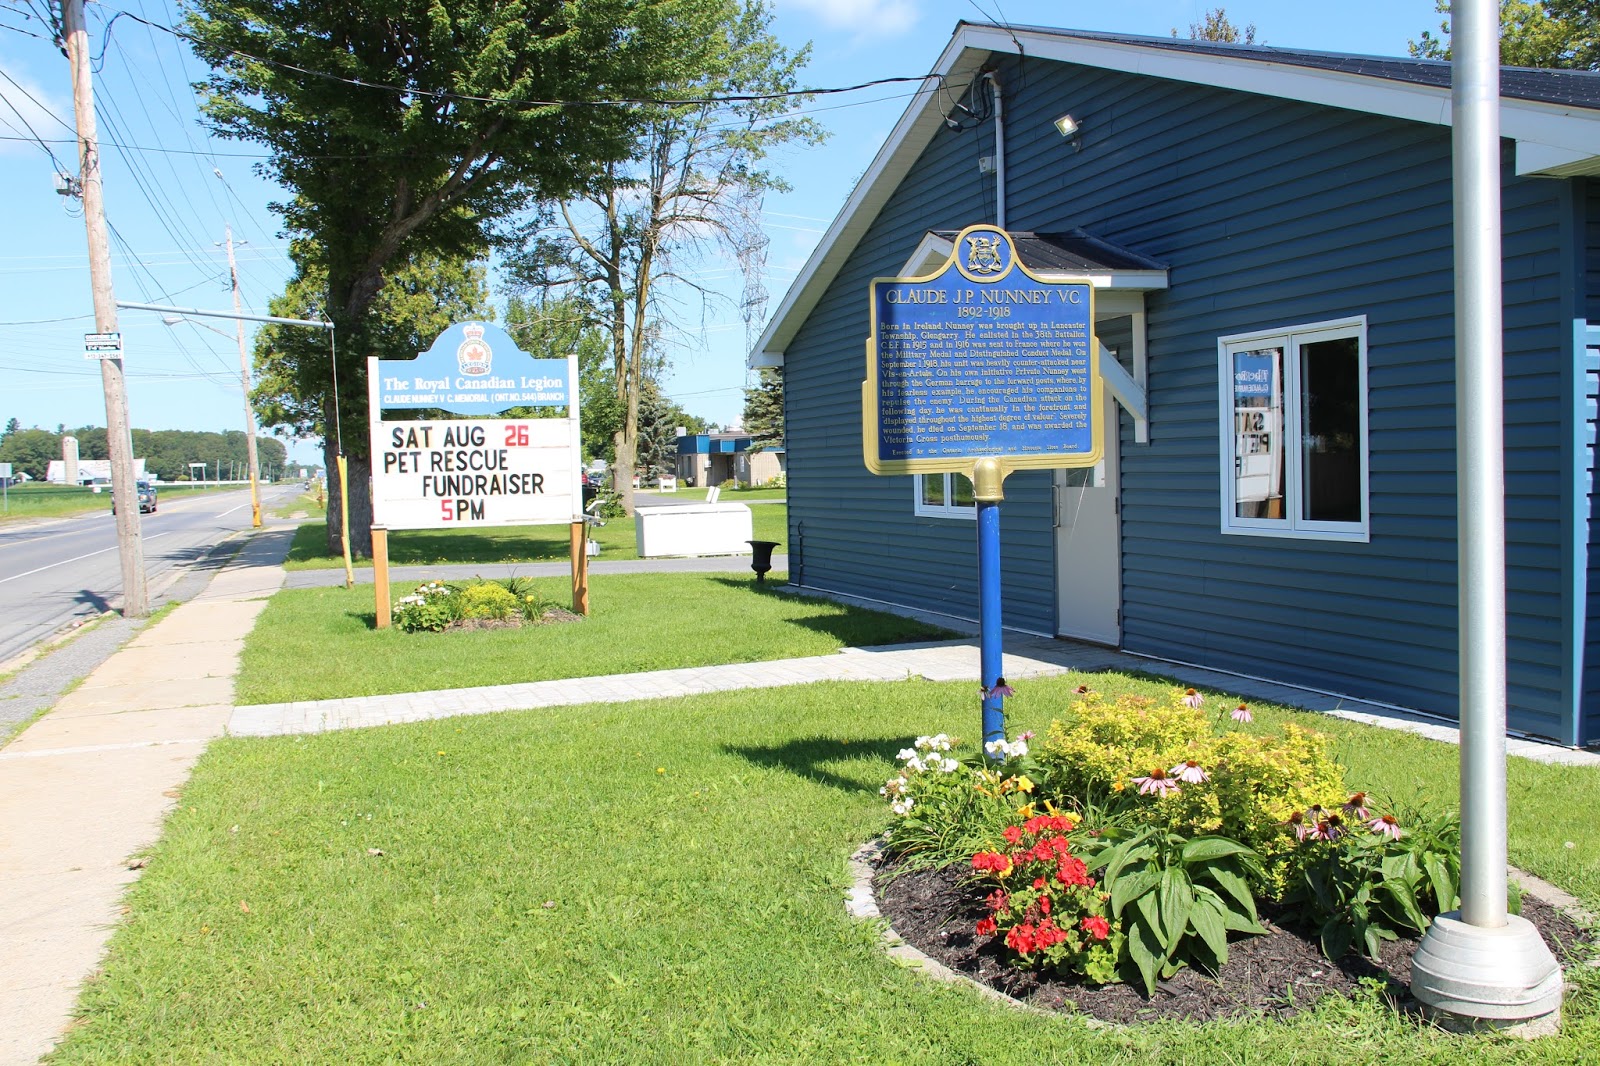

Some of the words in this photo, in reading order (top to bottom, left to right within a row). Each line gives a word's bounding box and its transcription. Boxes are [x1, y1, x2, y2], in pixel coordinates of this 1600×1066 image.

[886, 288, 948, 304] CLAUDE
[952, 290, 974, 304] J.P.
[1057, 290, 1082, 304] V.C.
[958, 306, 1011, 320] 1892-1918
[945, 322, 974, 331] Nunney
[996, 322, 1024, 331] brought
[912, 341, 927, 350] 1915
[956, 340, 970, 349] 1916
[896, 351, 926, 360] Military
[970, 350, 1018, 359] Distinguished
[882, 361, 917, 370] September
[986, 360, 1010, 368] heavily
[1042, 368, 1068, 377] Nunney
[384, 377, 410, 390] The
[414, 376, 450, 394] Royal
[455, 376, 516, 390] Canadian
[520, 376, 563, 392] Legion
[882, 380, 909, 389] through
[956, 379, 982, 387] barrage
[1078, 377, 1086, 385] by
[978, 387, 1018, 396] encouraged
[1036, 386, 1076, 395] companions
[384, 395, 411, 404] CLAUDE
[538, 392, 564, 401] BRANCH
[882, 398, 910, 408] repulse
[960, 397, 986, 406] During
[882, 408, 916, 417] following
[967, 406, 1008, 415] continually
[918, 416, 956, 426] throughout
[971, 415, 996, 424] highest
[998, 414, 1022, 423] degree
[1060, 413, 1086, 422] Severely
[958, 424, 996, 434] September
[392, 426, 432, 448] SAT
[444, 426, 486, 448] AUG
[504, 424, 529, 446] 26
[384, 452, 422, 474] PET
[430, 450, 508, 472] RESCUE
[423, 474, 544, 497] FUNDRAISER
